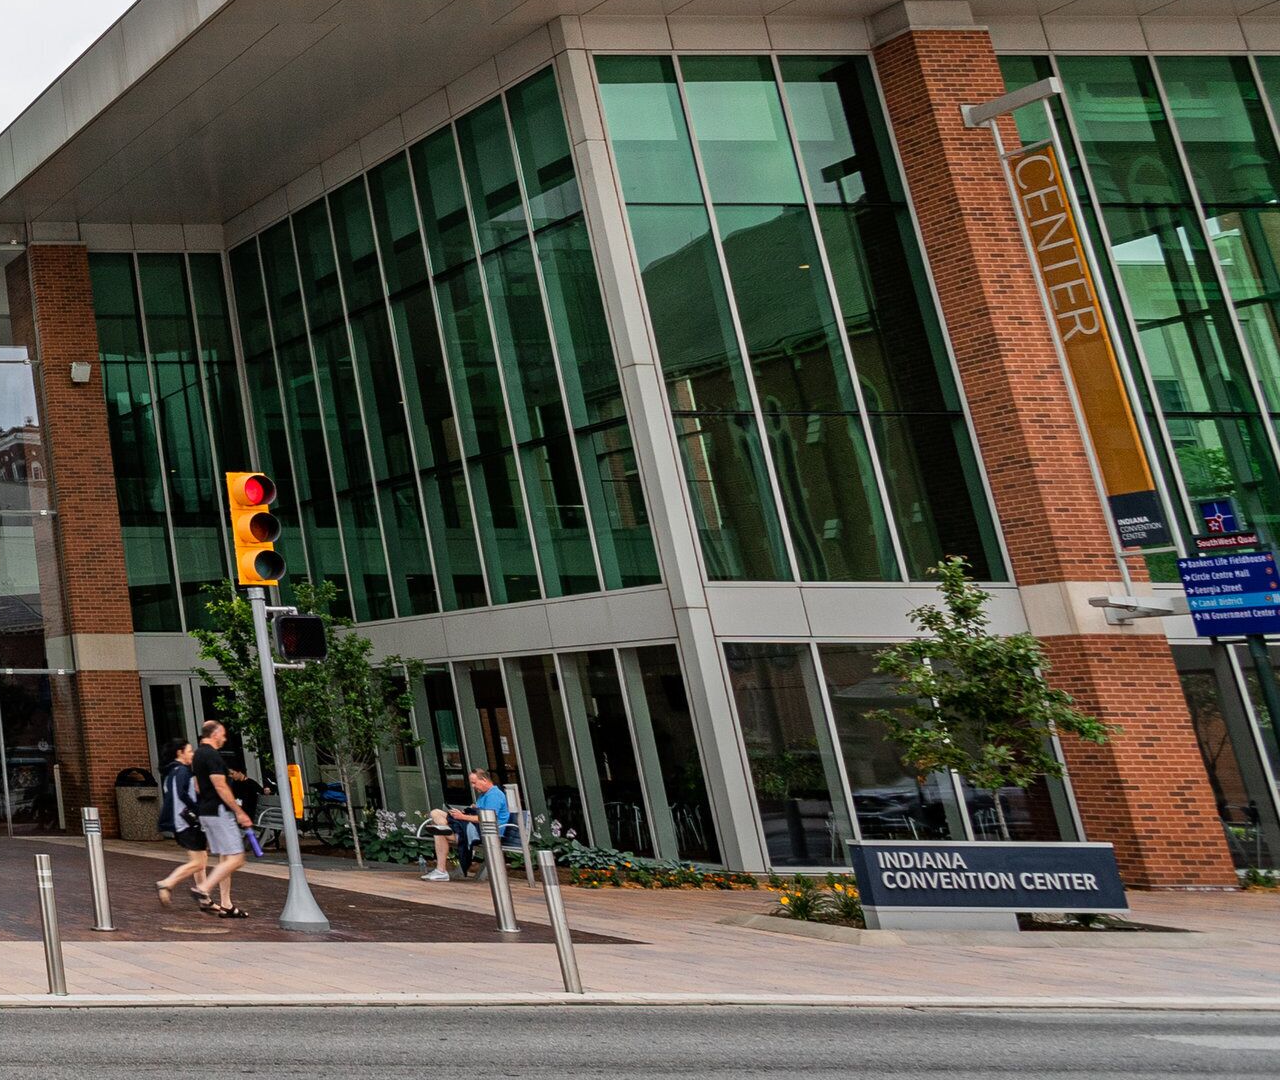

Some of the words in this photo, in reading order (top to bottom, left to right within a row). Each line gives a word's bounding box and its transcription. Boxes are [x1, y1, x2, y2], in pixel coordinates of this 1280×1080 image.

[1015, 155, 1100, 342] CENTER
[1117, 516, 1149, 526] INDIANA
[1120, 522, 1163, 533] CONVENTION
[1121, 531, 1147, 540] CENTER
[1237, 534, 1258, 544] Quad
[1187, 559, 1215, 569] Bankers
[1215, 557, 1228, 566] Life
[1229, 555, 1266, 565] Fieldhouse
[1191, 572, 1210, 581] Circle
[1211, 571, 1234, 580] Centre
[1234, 569, 1251, 578] Mall
[1194, 585, 1221, 595] Georgia
[1221, 584, 1243, 593] Street
[1198, 599, 1217, 607] Canal
[1218, 597, 1244, 606] District
[1211, 610, 1252, 620] Government
[1252, 608, 1276, 618] Center
[877, 851, 968, 869] INDIANA
[882, 871, 1017, 890] CONVENTION
[1019, 872, 1100, 891] CENTER
